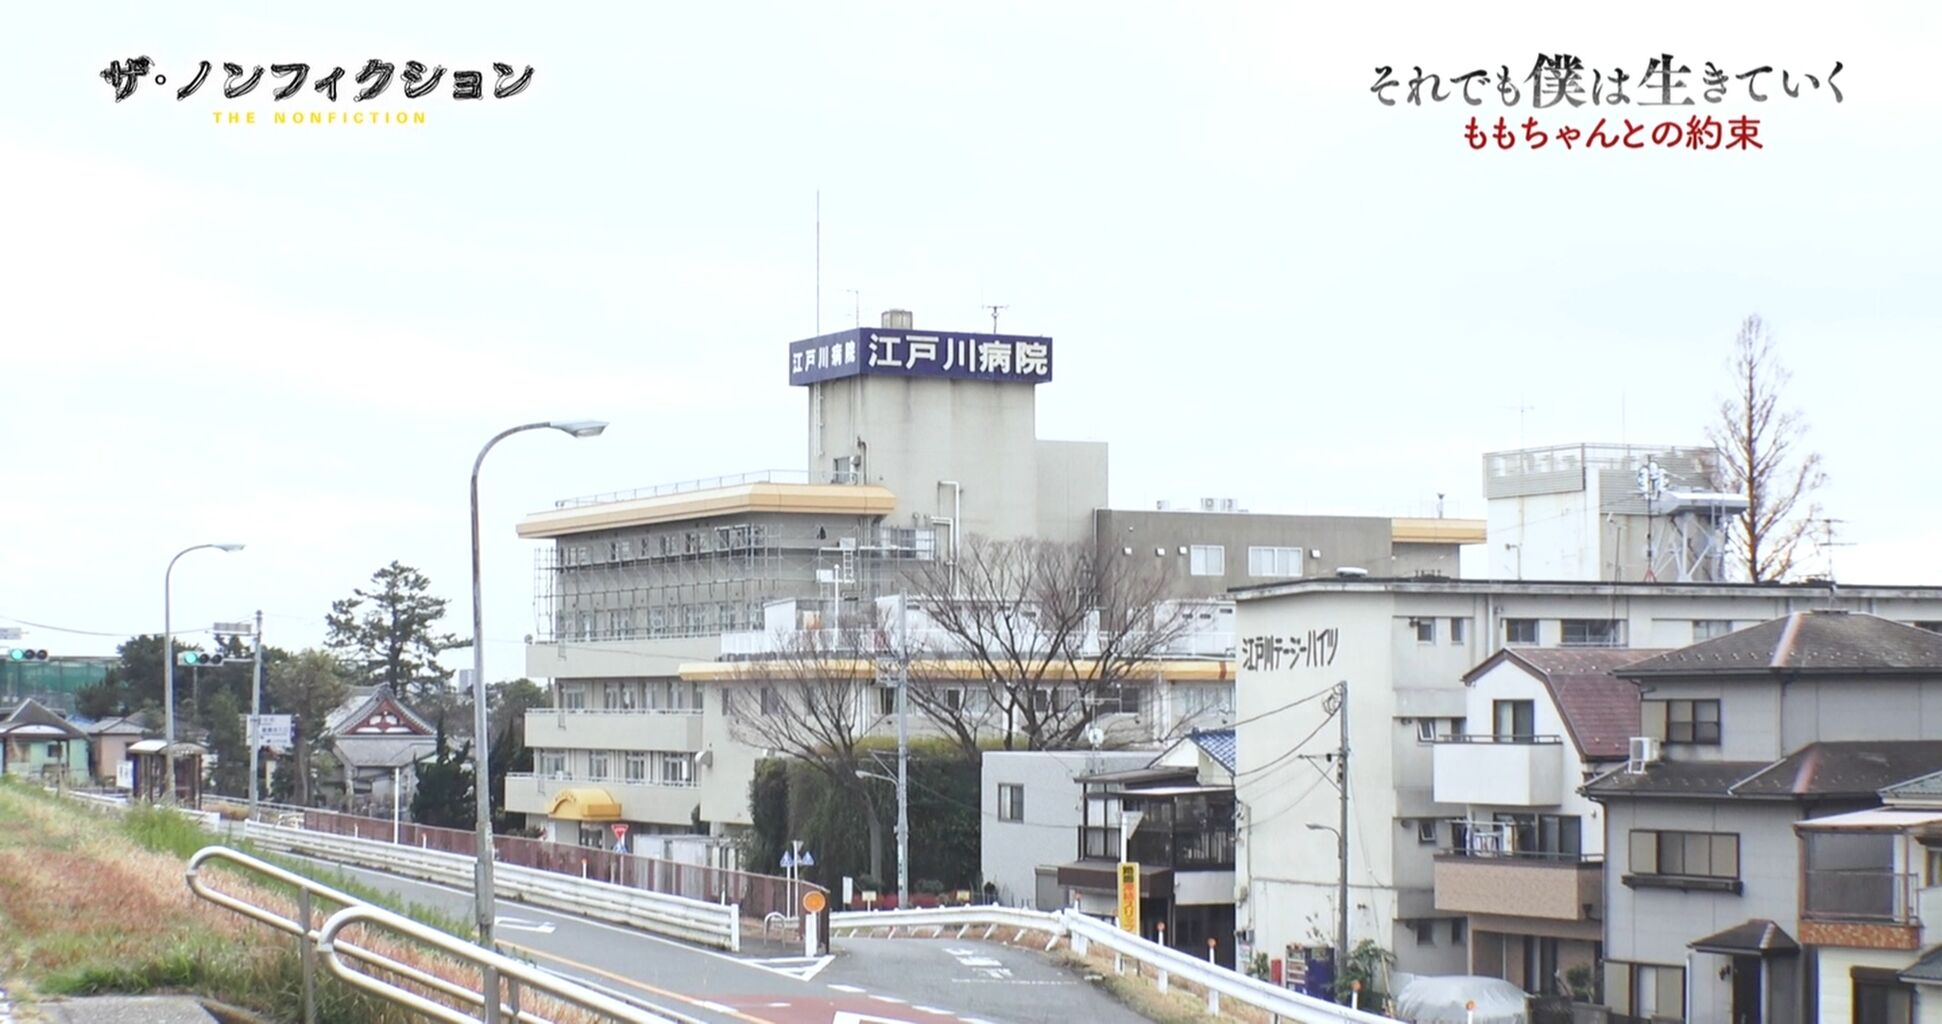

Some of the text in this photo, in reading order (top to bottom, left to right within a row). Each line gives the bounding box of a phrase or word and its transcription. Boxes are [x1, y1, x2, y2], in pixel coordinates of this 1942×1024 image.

[791, 339, 857, 375] 江戸川病院
[867, 332, 1049, 376] 江戸川病院
